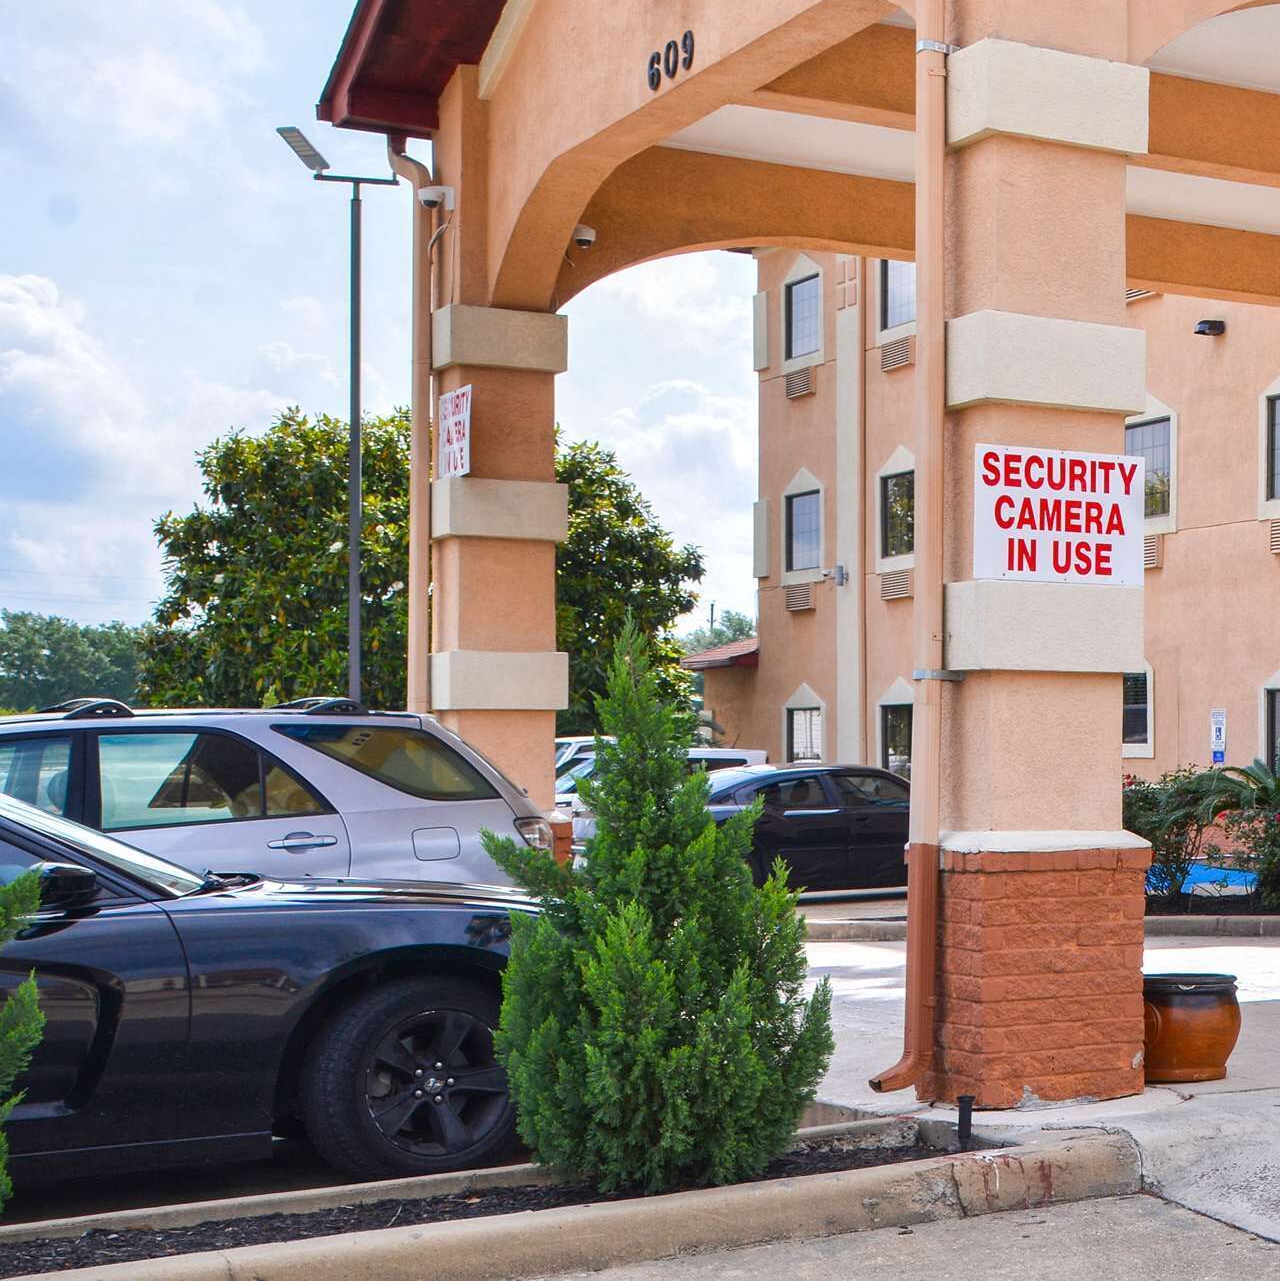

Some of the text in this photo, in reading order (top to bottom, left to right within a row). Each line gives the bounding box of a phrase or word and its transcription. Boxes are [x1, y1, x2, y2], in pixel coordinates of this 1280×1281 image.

[647, 29, 695, 92] 609
[982, 451, 1138, 495] SECURITY
[994, 494, 1126, 536] CAMERA
[1007, 538, 1113, 576] IN USE
